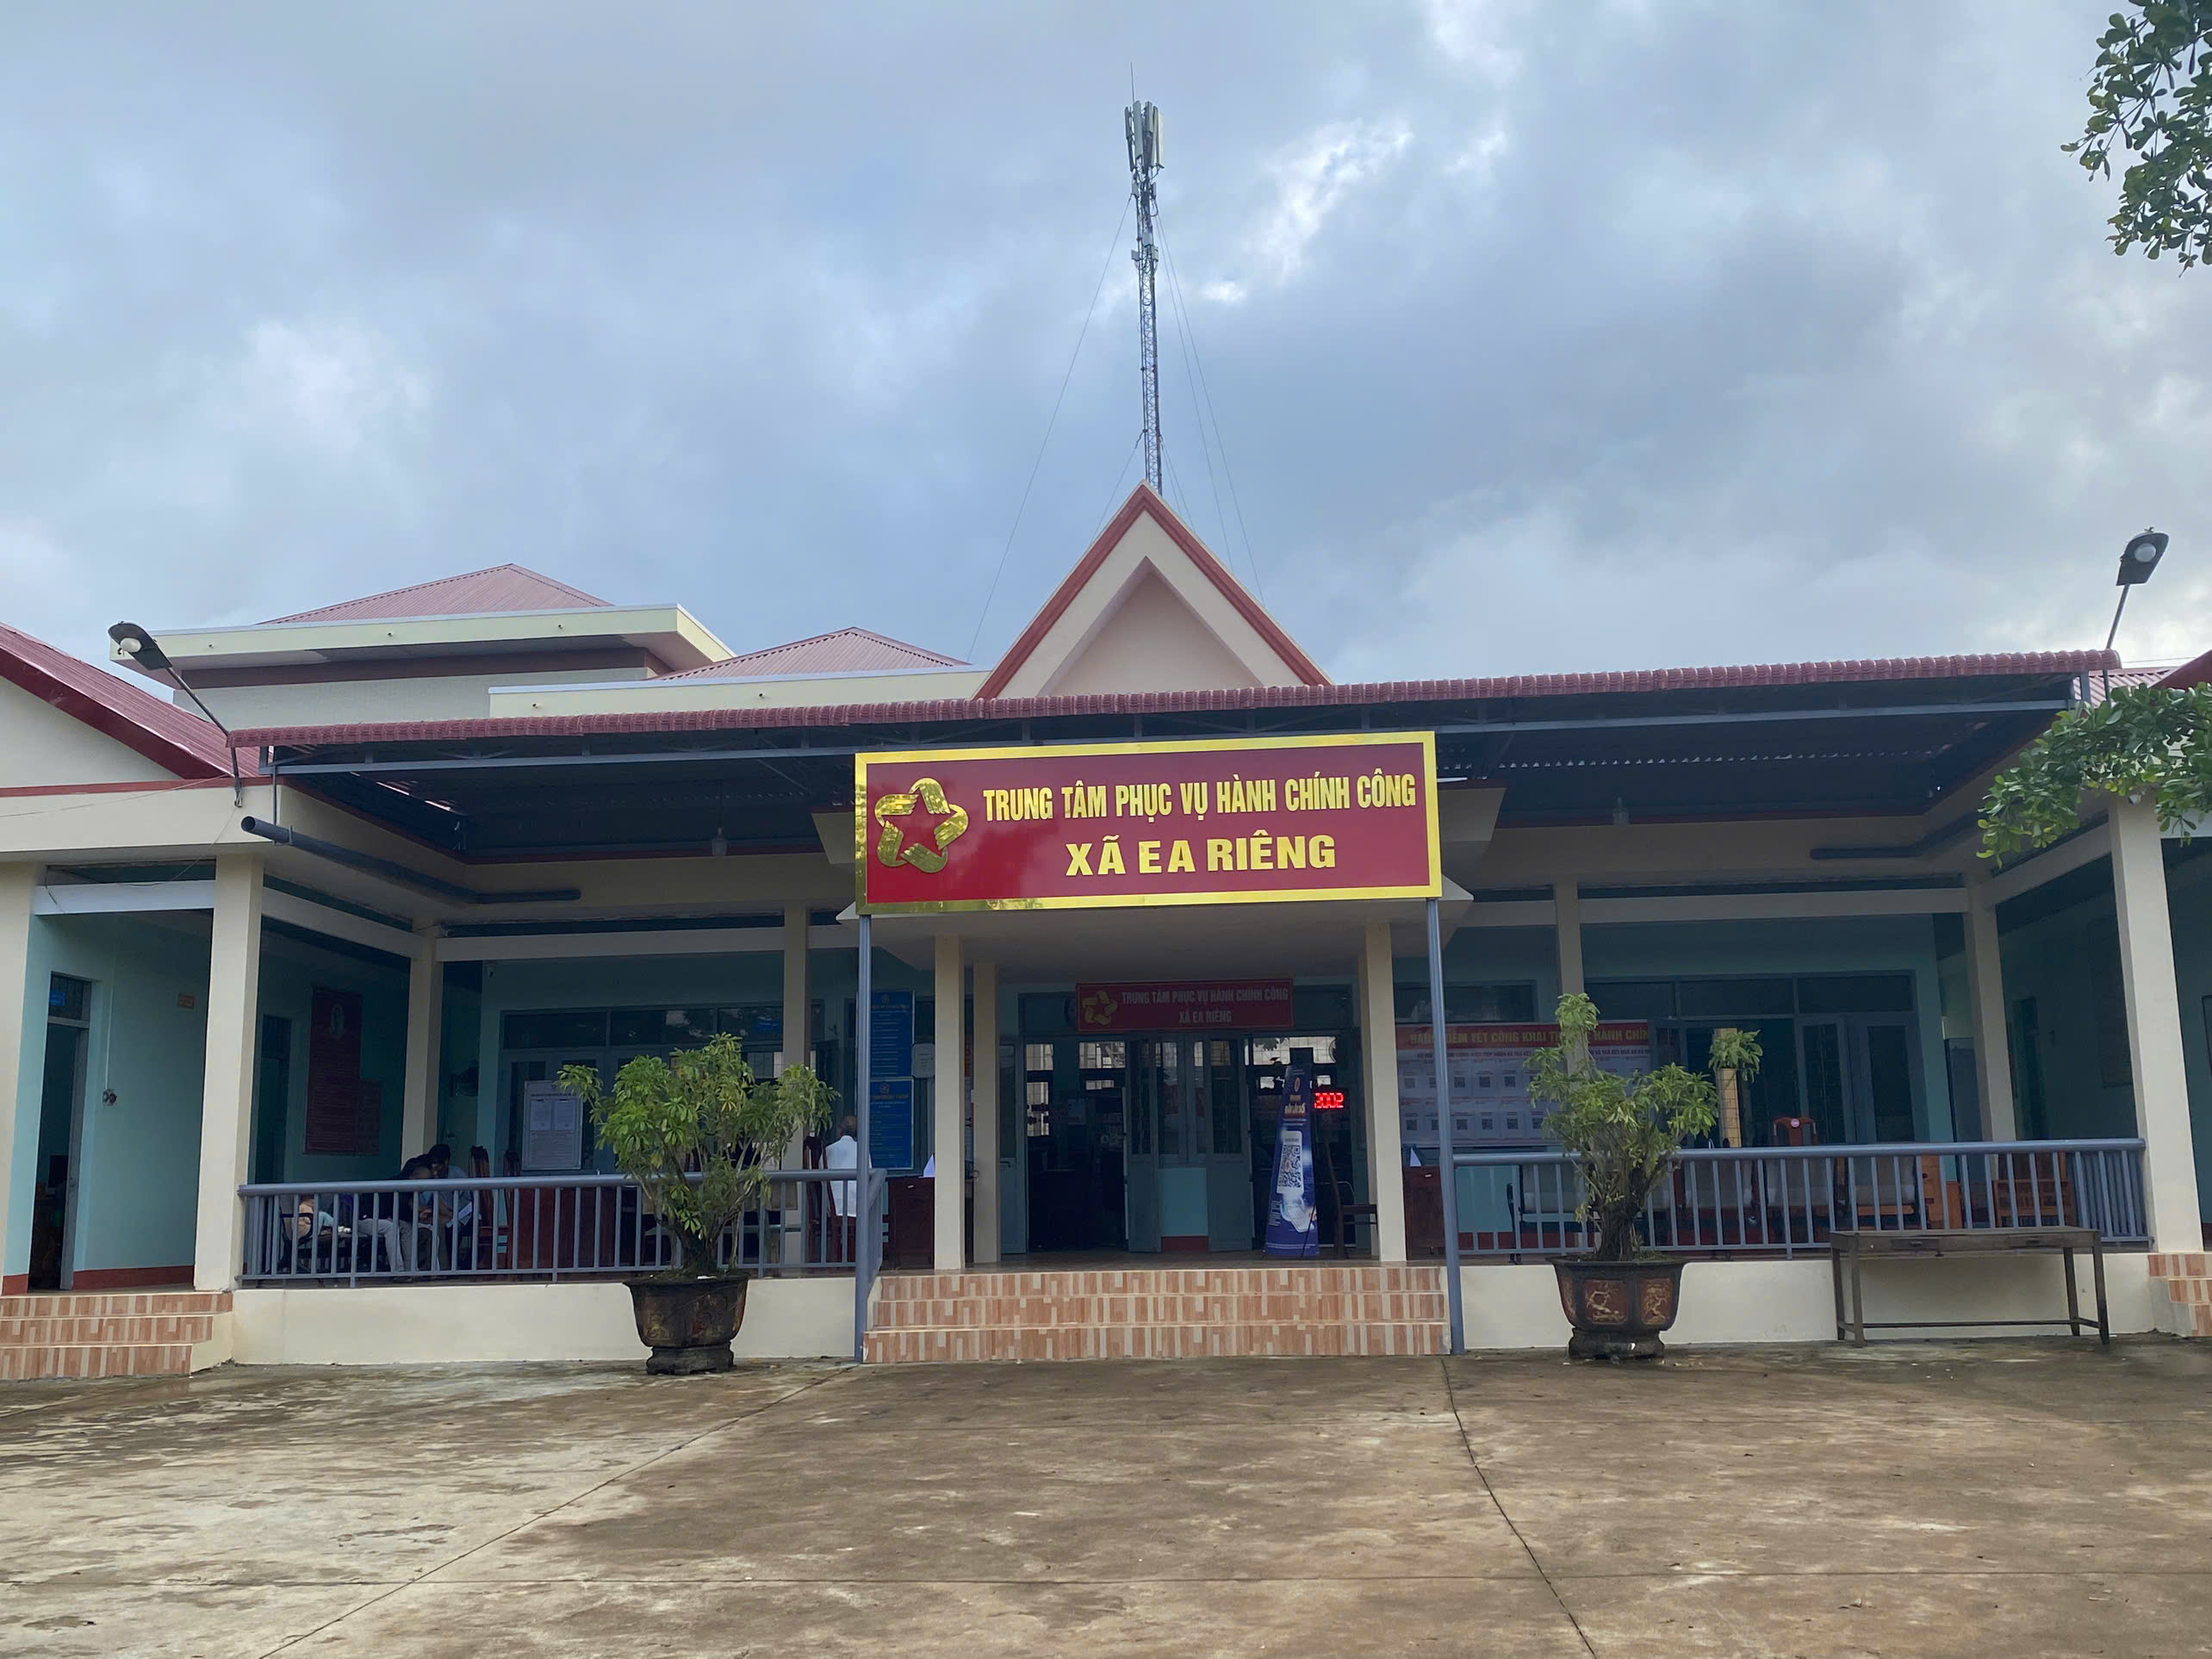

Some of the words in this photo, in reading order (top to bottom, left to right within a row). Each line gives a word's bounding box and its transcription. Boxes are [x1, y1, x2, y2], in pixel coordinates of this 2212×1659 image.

[983, 787, 1053, 822] TRUNG
[1061, 780, 1107, 818] TÂM
[1115, 783, 1172, 823] PHỤC
[1179, 781, 1209, 821] VỤ
[1216, 774, 1277, 814] HÀNH
[1284, 771, 1351, 812] CHÍNH
[1357, 767, 1416, 809] CÔNG
[1066, 834, 1127, 877] XÃ
[1138, 839, 1196, 874] EA
[1206, 829, 1336, 873] RIÊNG
[1122, 991, 1150, 1004] TRUNG
[1152, 989, 1170, 1003] TÂM
[1171, 990, 1196, 1005] PHỤC
[1210, 988, 1234, 1003] HÀNH
[1236, 988, 1263, 1002] CHÍNH
[1264, 986, 1289, 1001] CÔNG
[1192, 1010, 1204, 1023] EA
